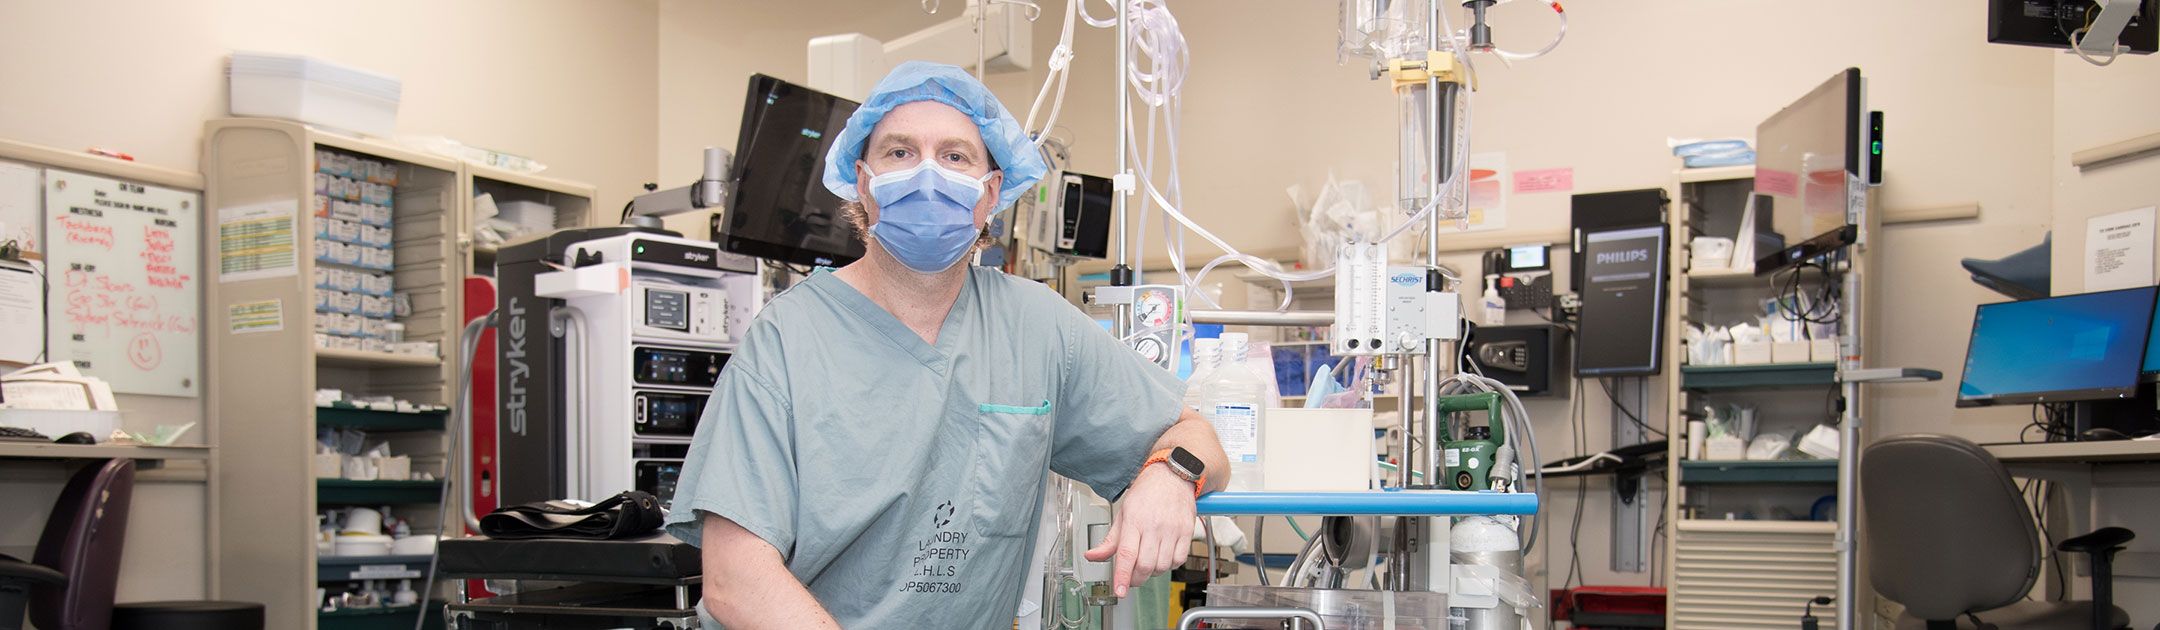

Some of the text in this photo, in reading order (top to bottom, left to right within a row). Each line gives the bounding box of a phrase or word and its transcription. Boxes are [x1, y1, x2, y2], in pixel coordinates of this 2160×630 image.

[684, 252, 710, 262] stryker
[1596, 248, 1648, 264] PHILIPS
[1391, 276, 1423, 284] SECHRIST
[506, 297, 530, 436] stryker
